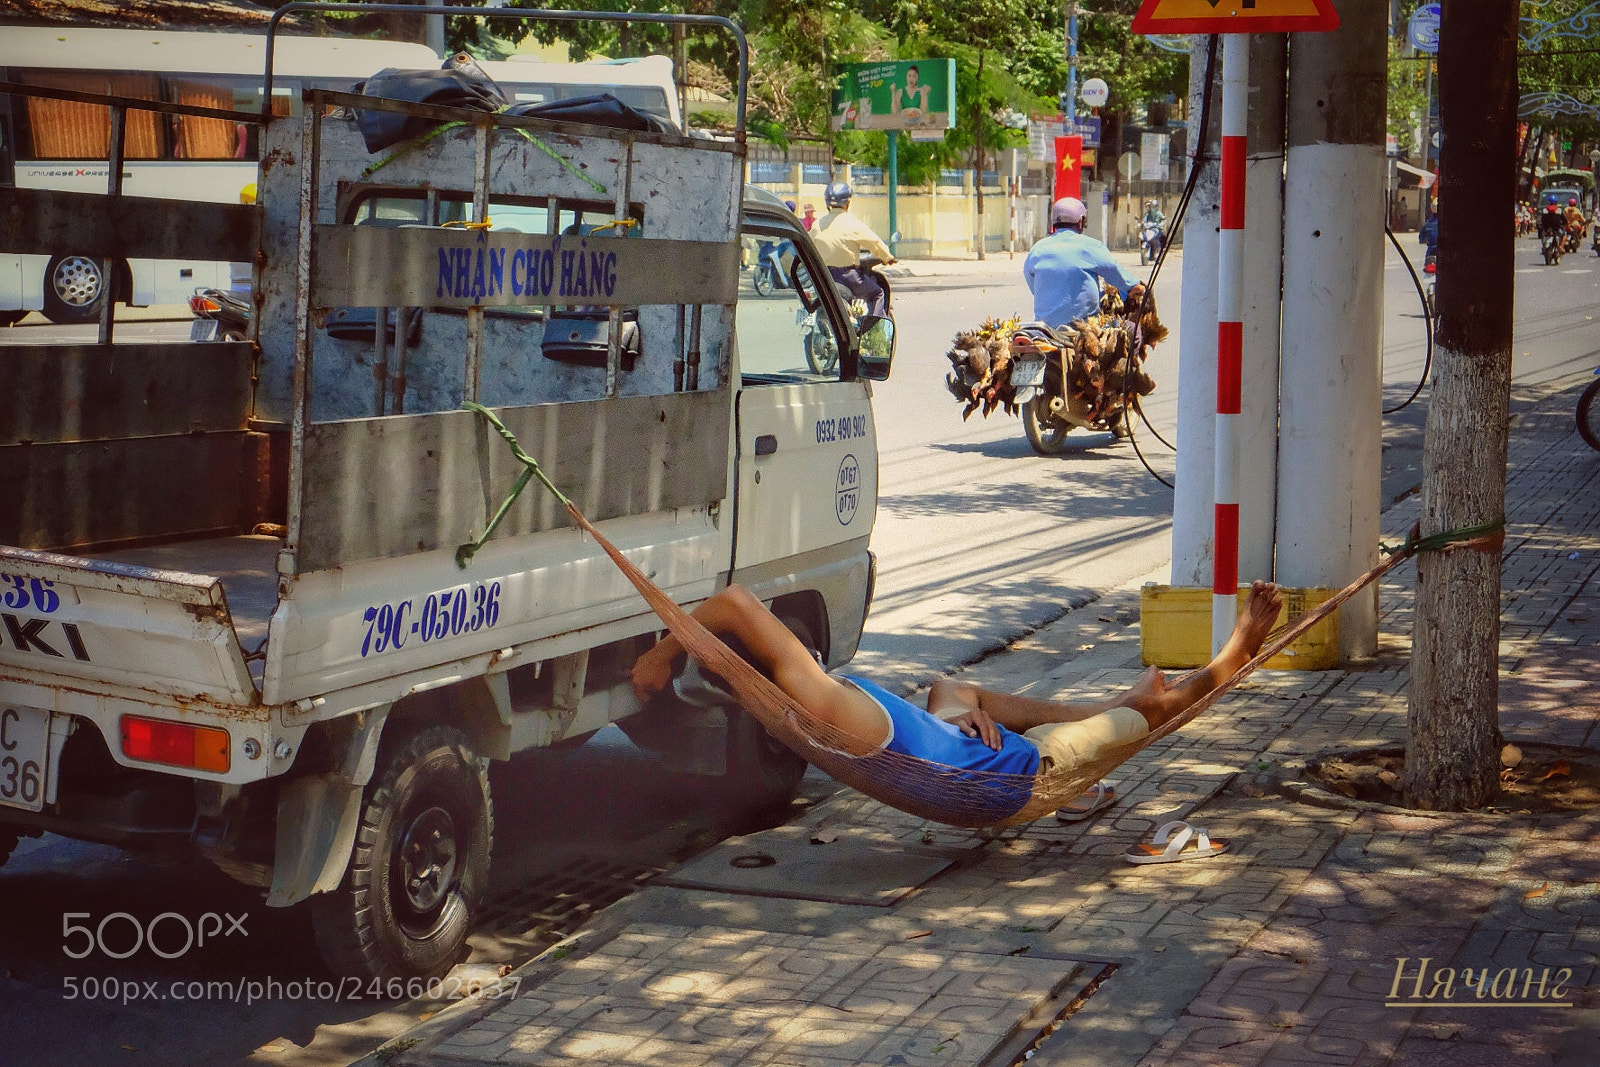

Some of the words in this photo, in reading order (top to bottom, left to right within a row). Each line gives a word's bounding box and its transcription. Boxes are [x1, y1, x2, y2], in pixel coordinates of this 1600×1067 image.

[436, 231, 506, 305] NHẬN
[558, 238, 617, 298] HÀNG
[816, 419, 836, 444] 0932
[837, 417, 852, 440] 490
[853, 414, 866, 438] 902
[0, 613, 91, 662] KI
[361, 581, 501, 658] 79C-050.36
[1, 708, 20, 751] C
[1, 756, 40, 802] 36
